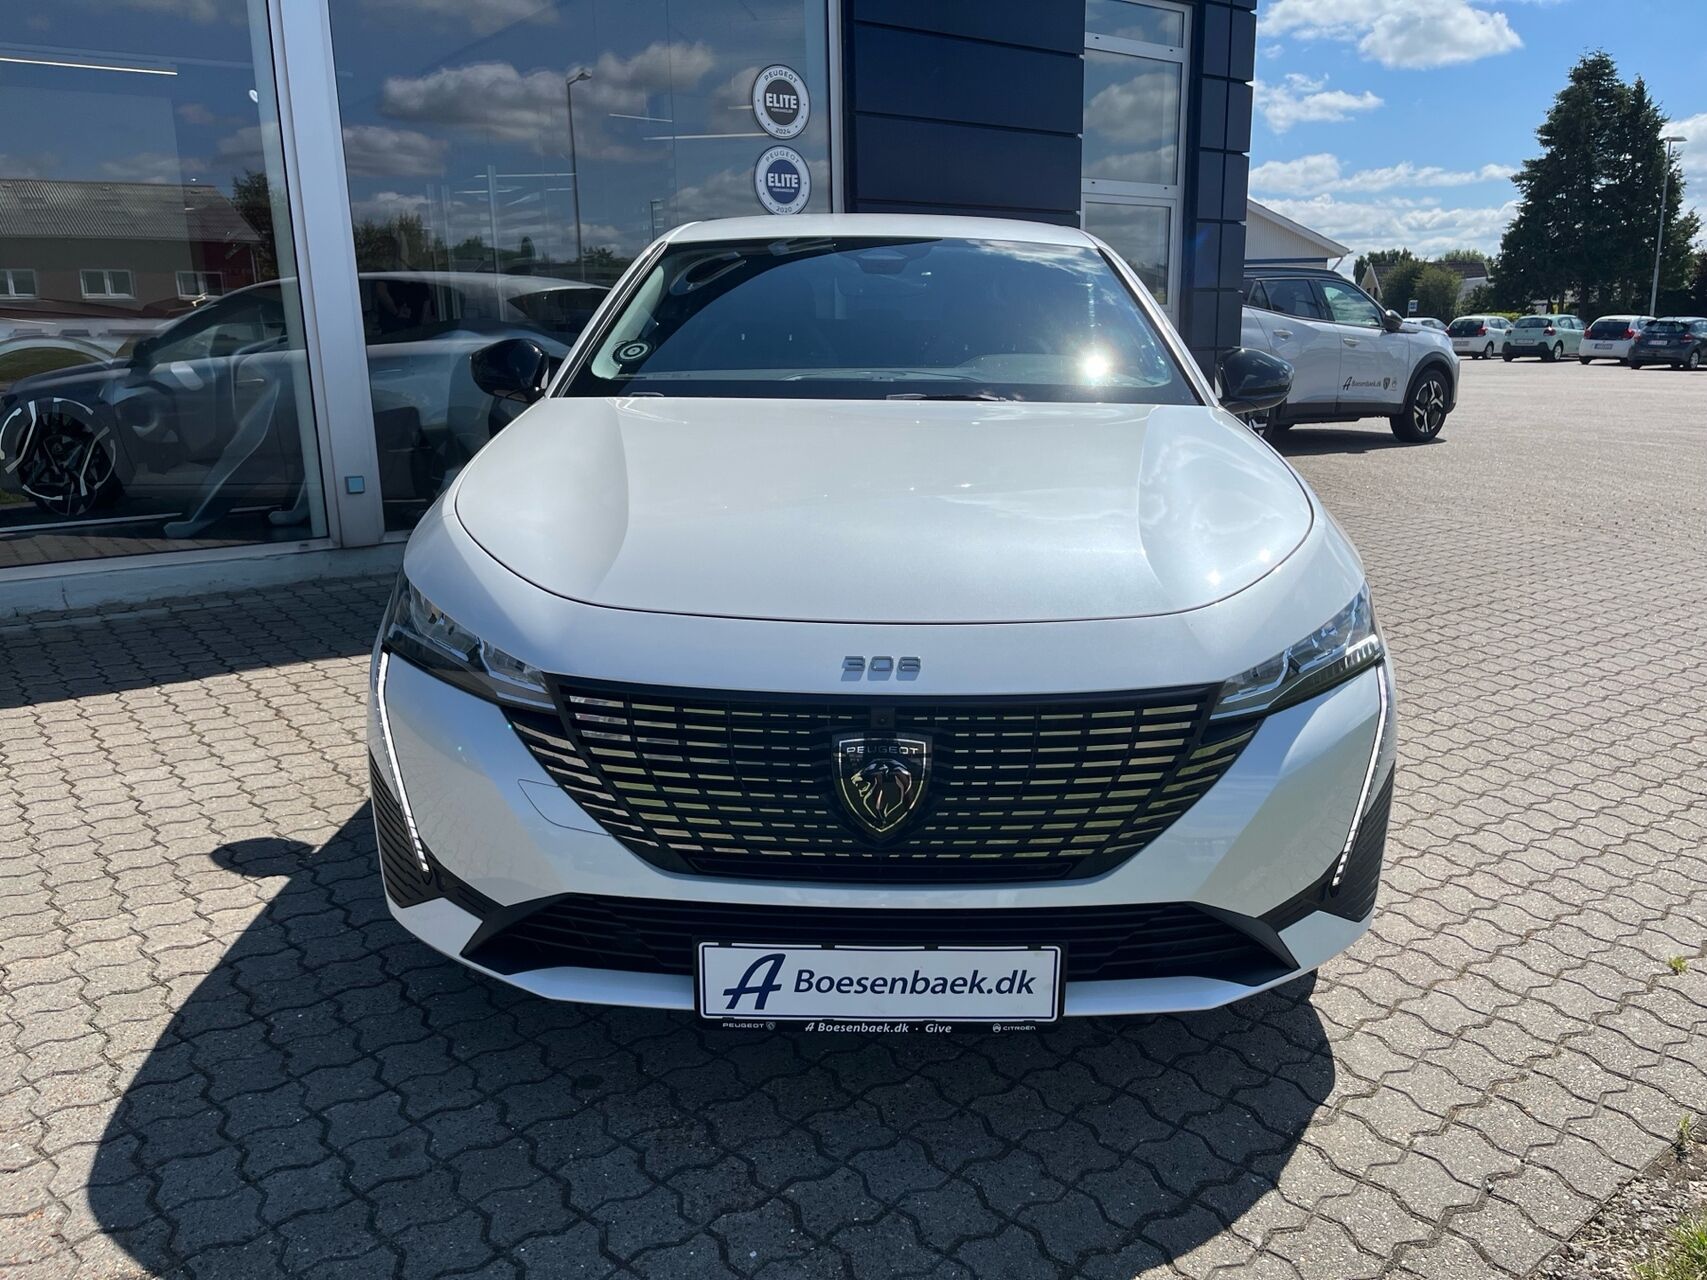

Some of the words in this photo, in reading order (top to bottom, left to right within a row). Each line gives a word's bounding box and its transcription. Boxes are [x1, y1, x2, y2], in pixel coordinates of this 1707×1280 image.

[764, 69, 798, 83] PEUGEOT
[765, 92, 798, 109] ELITE
[775, 127, 791, 135] 2024
[765, 150, 799, 163] PEUGEOT
[767, 172, 799, 188] ELITE
[841, 655, 921, 675] 308
[846, 745, 919, 755] PEUGEOT
[793, 969, 1038, 995] Boesenbaek.dk
[817, 1022, 910, 1034] Boesenbaek.dk
[925, 1023, 952, 1035] Give
